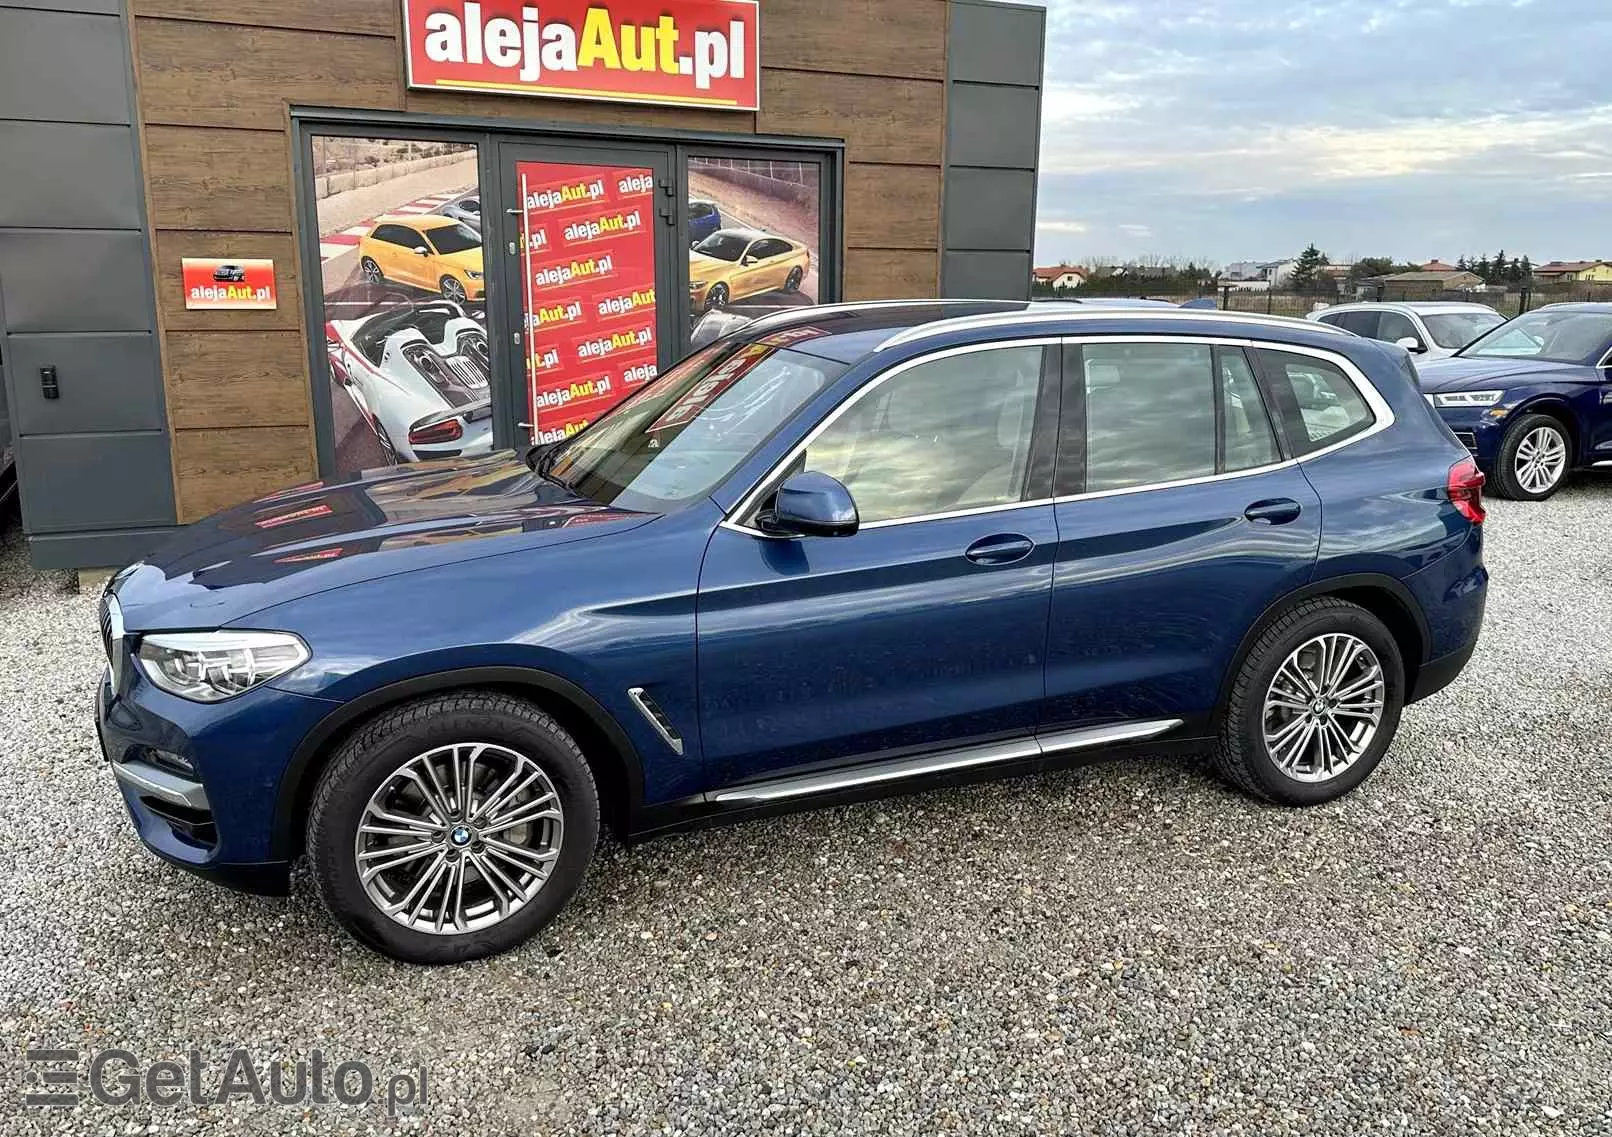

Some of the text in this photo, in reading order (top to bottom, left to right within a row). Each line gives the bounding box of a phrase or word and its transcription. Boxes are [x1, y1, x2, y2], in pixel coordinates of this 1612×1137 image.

[424, 2, 745, 89] alejaAut.pl
[526, 180, 605, 210] alejaAut.pl
[564, 211, 641, 241] alejaAut.pl
[535, 255, 613, 286] alejaAut.pl
[191, 285, 271, 302] alejaAut.pl
[577, 327, 653, 357] alejaAut.pl
[536, 376, 611, 408] alejaAut.pl
